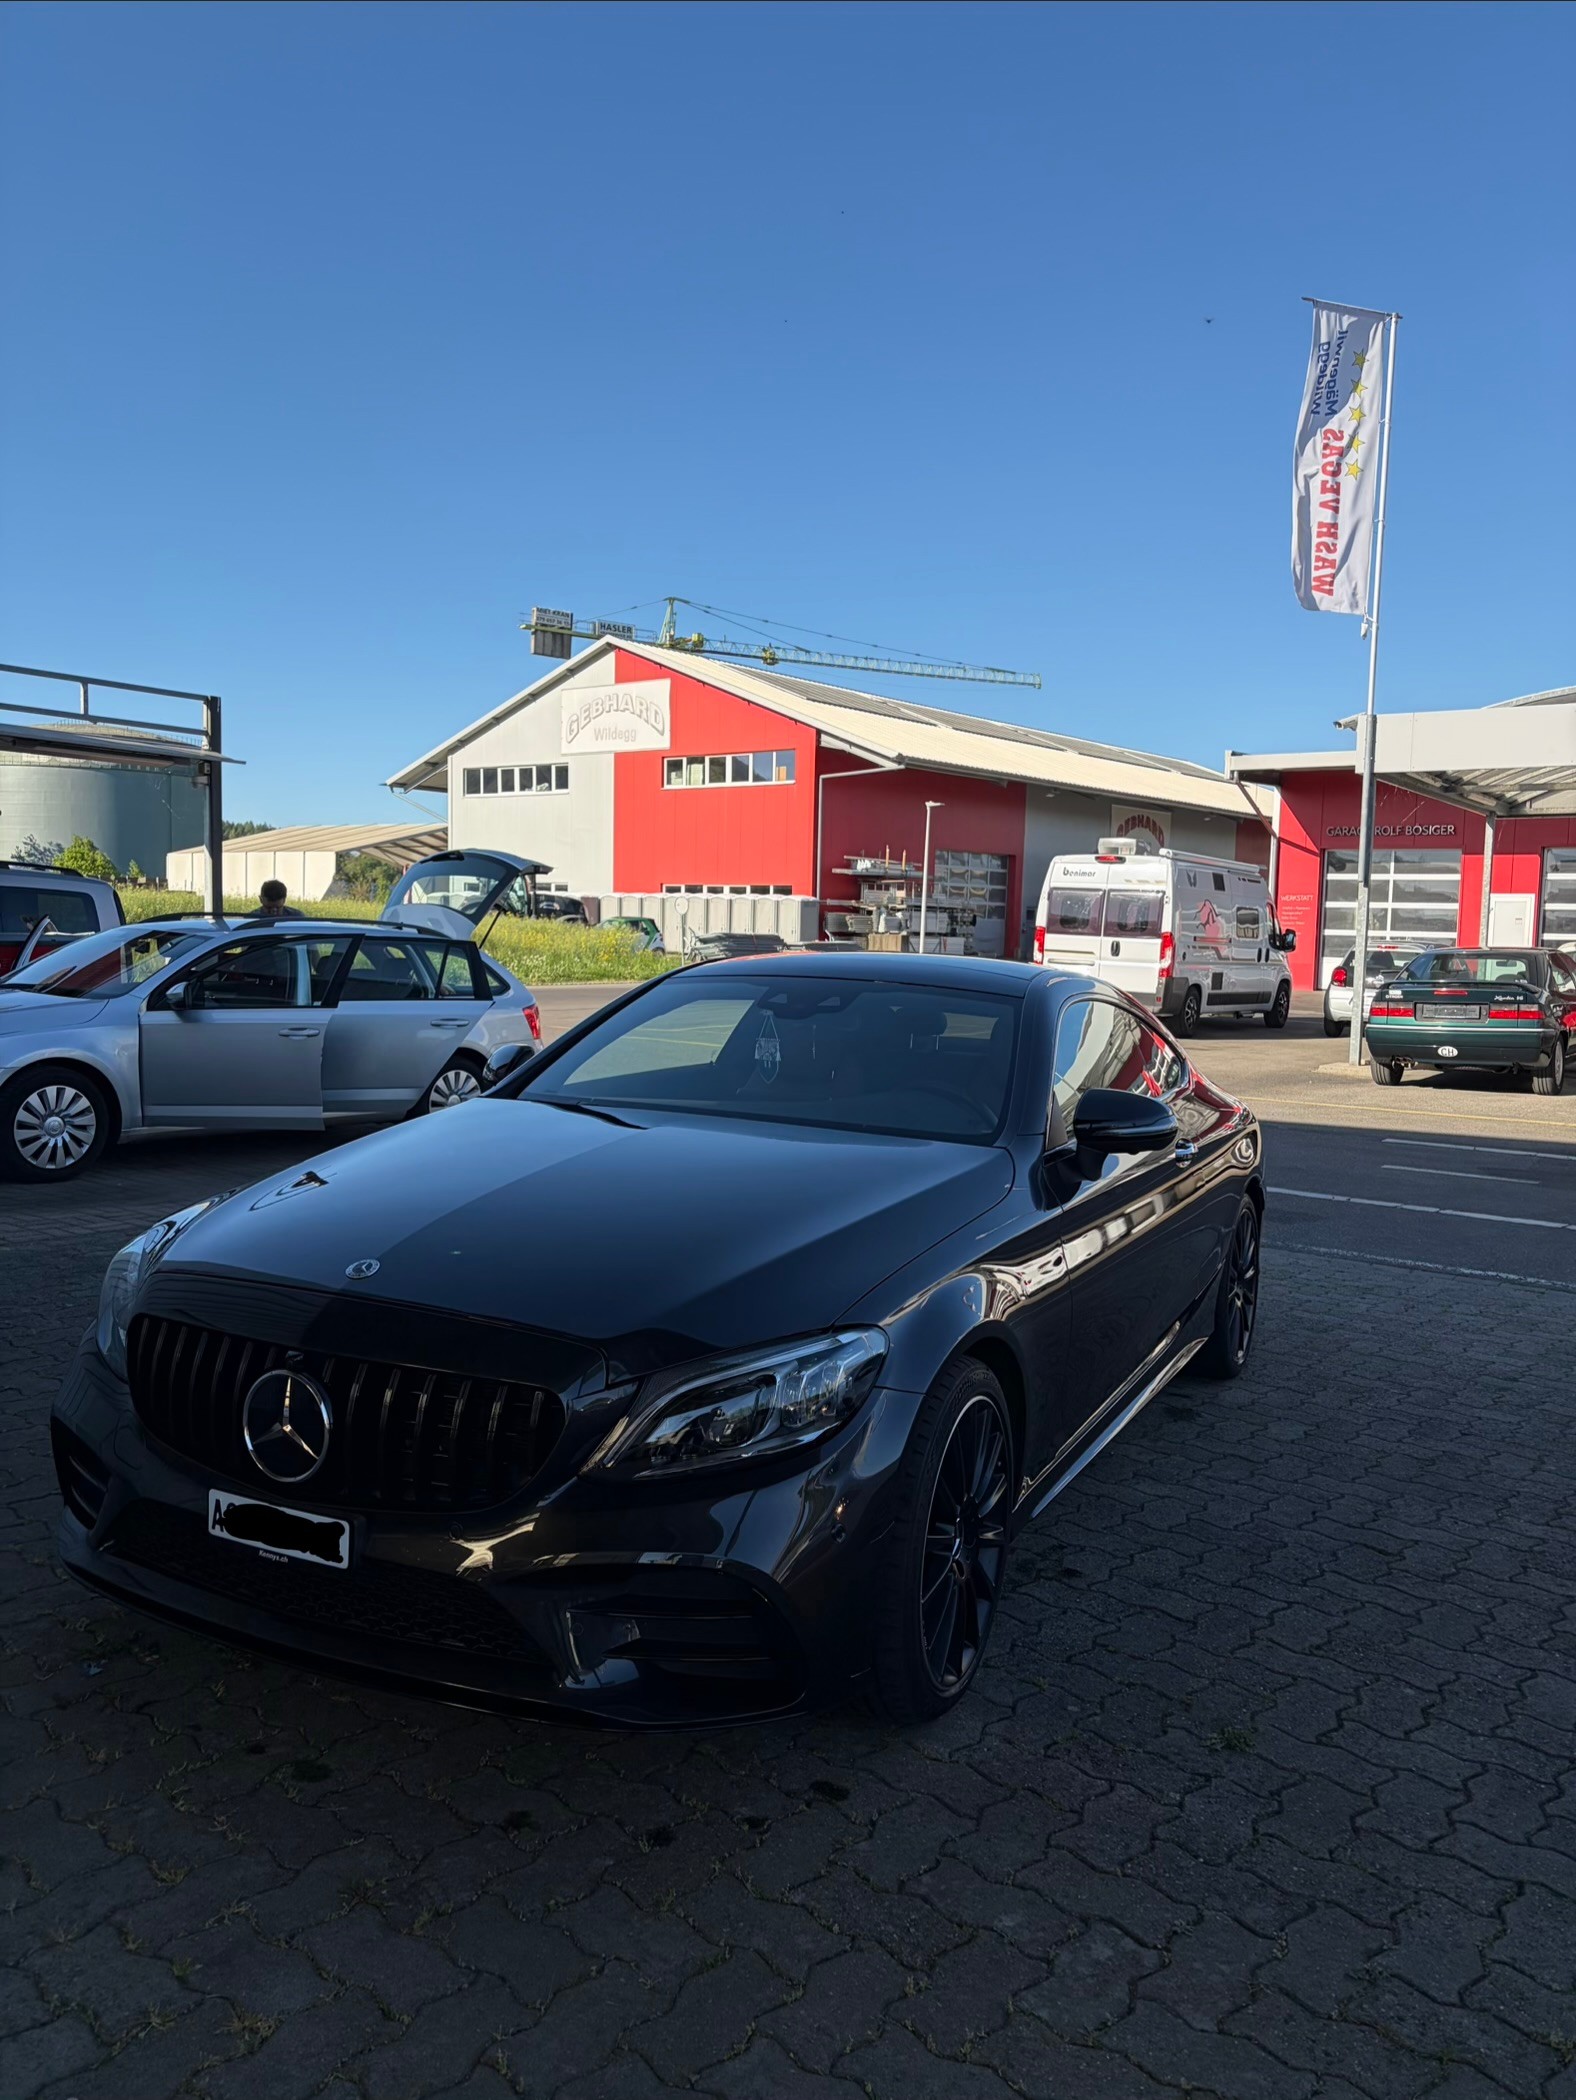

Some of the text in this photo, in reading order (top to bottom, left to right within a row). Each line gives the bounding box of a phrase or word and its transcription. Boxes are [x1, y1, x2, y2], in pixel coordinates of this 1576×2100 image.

[600, 621, 633, 634] HASLER
[566, 693, 665, 744] GEBHARD
[593, 727, 637, 743] Wildegg
[1374, 825, 1402, 836] ROLF
[1063, 866, 1096, 877] benimar
[1280, 894, 1314, 902] WERKSTATT
[1440, 1047, 1454, 1056] CH
